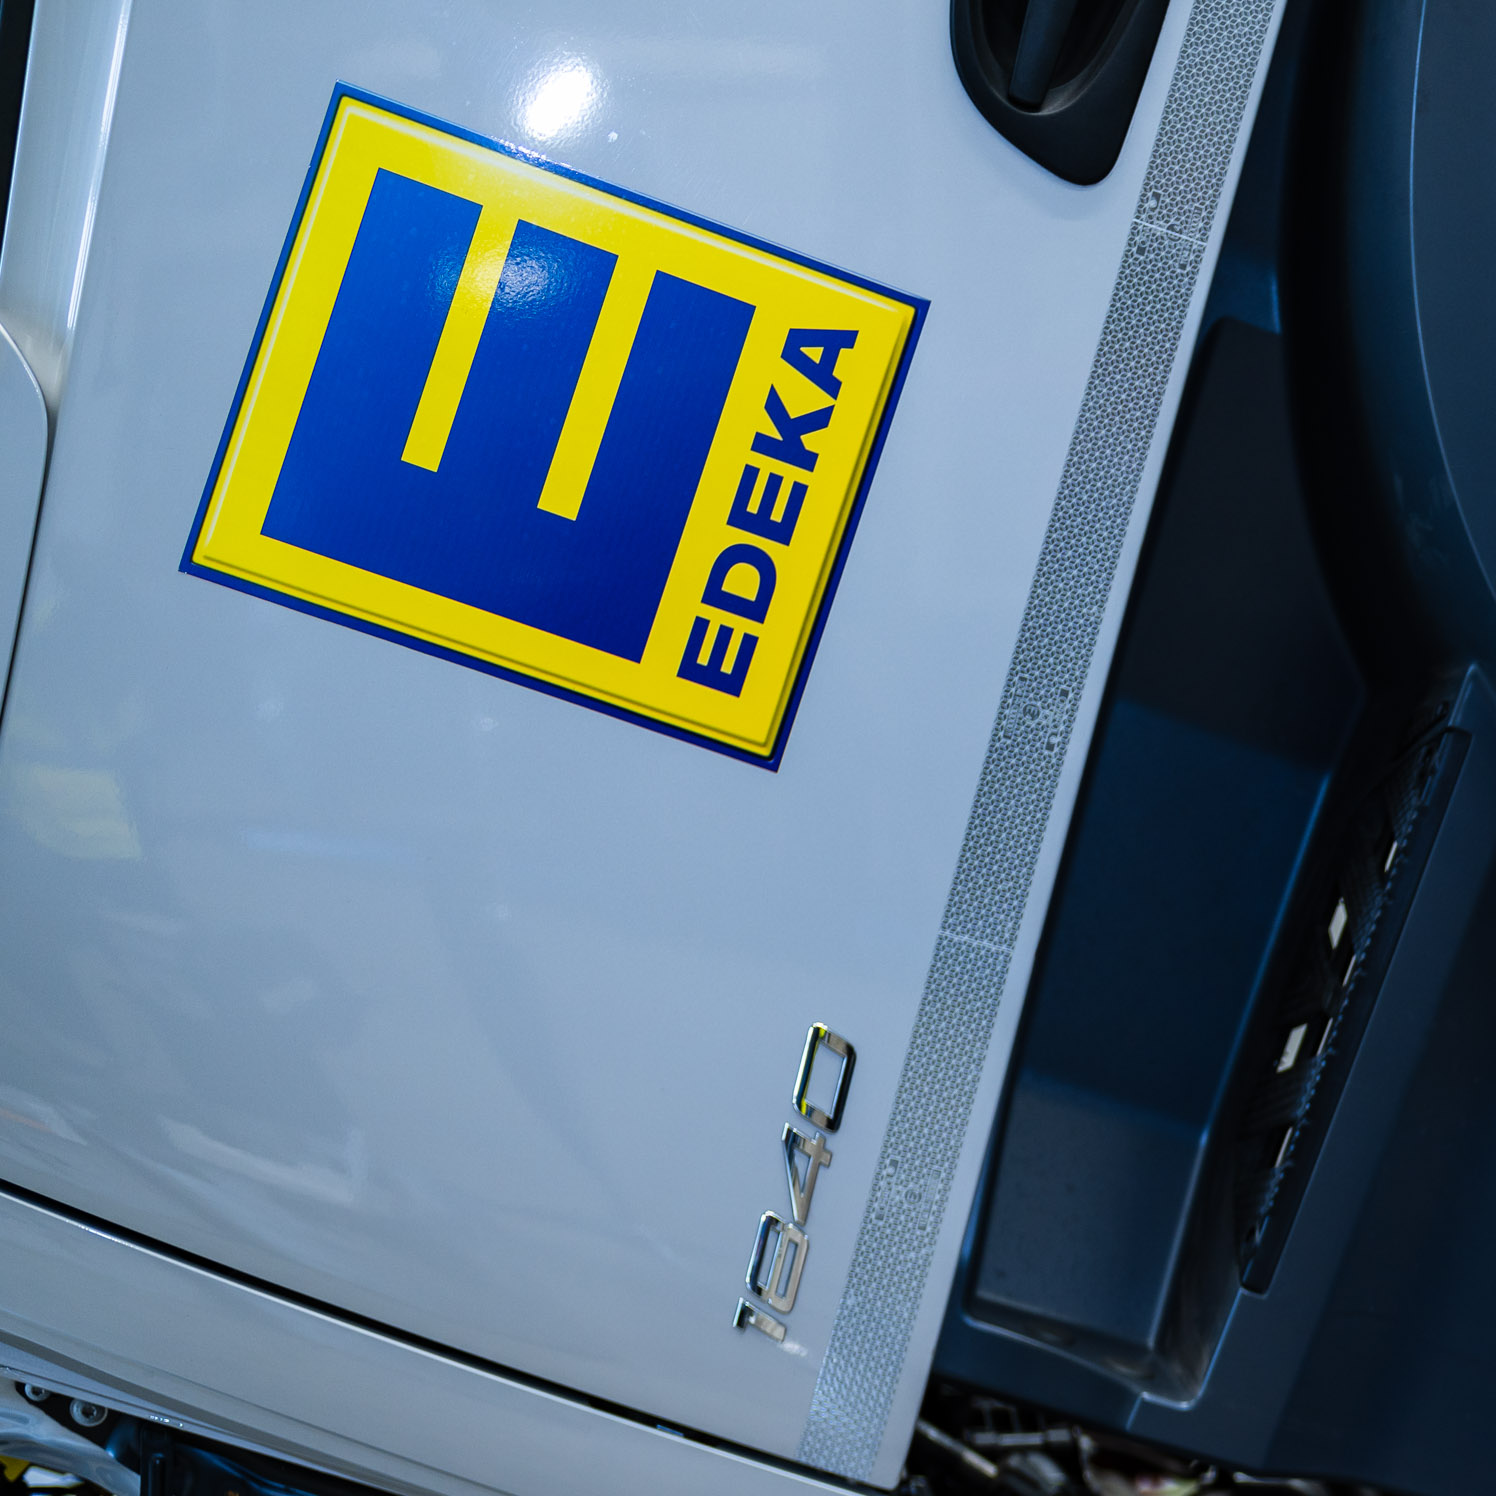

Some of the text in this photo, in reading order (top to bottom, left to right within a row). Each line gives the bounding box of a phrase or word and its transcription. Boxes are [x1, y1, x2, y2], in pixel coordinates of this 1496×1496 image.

[261, 167, 756, 663] E
[677, 328, 859, 698] EDEKA
[732, 1022, 857, 1342] 1840
